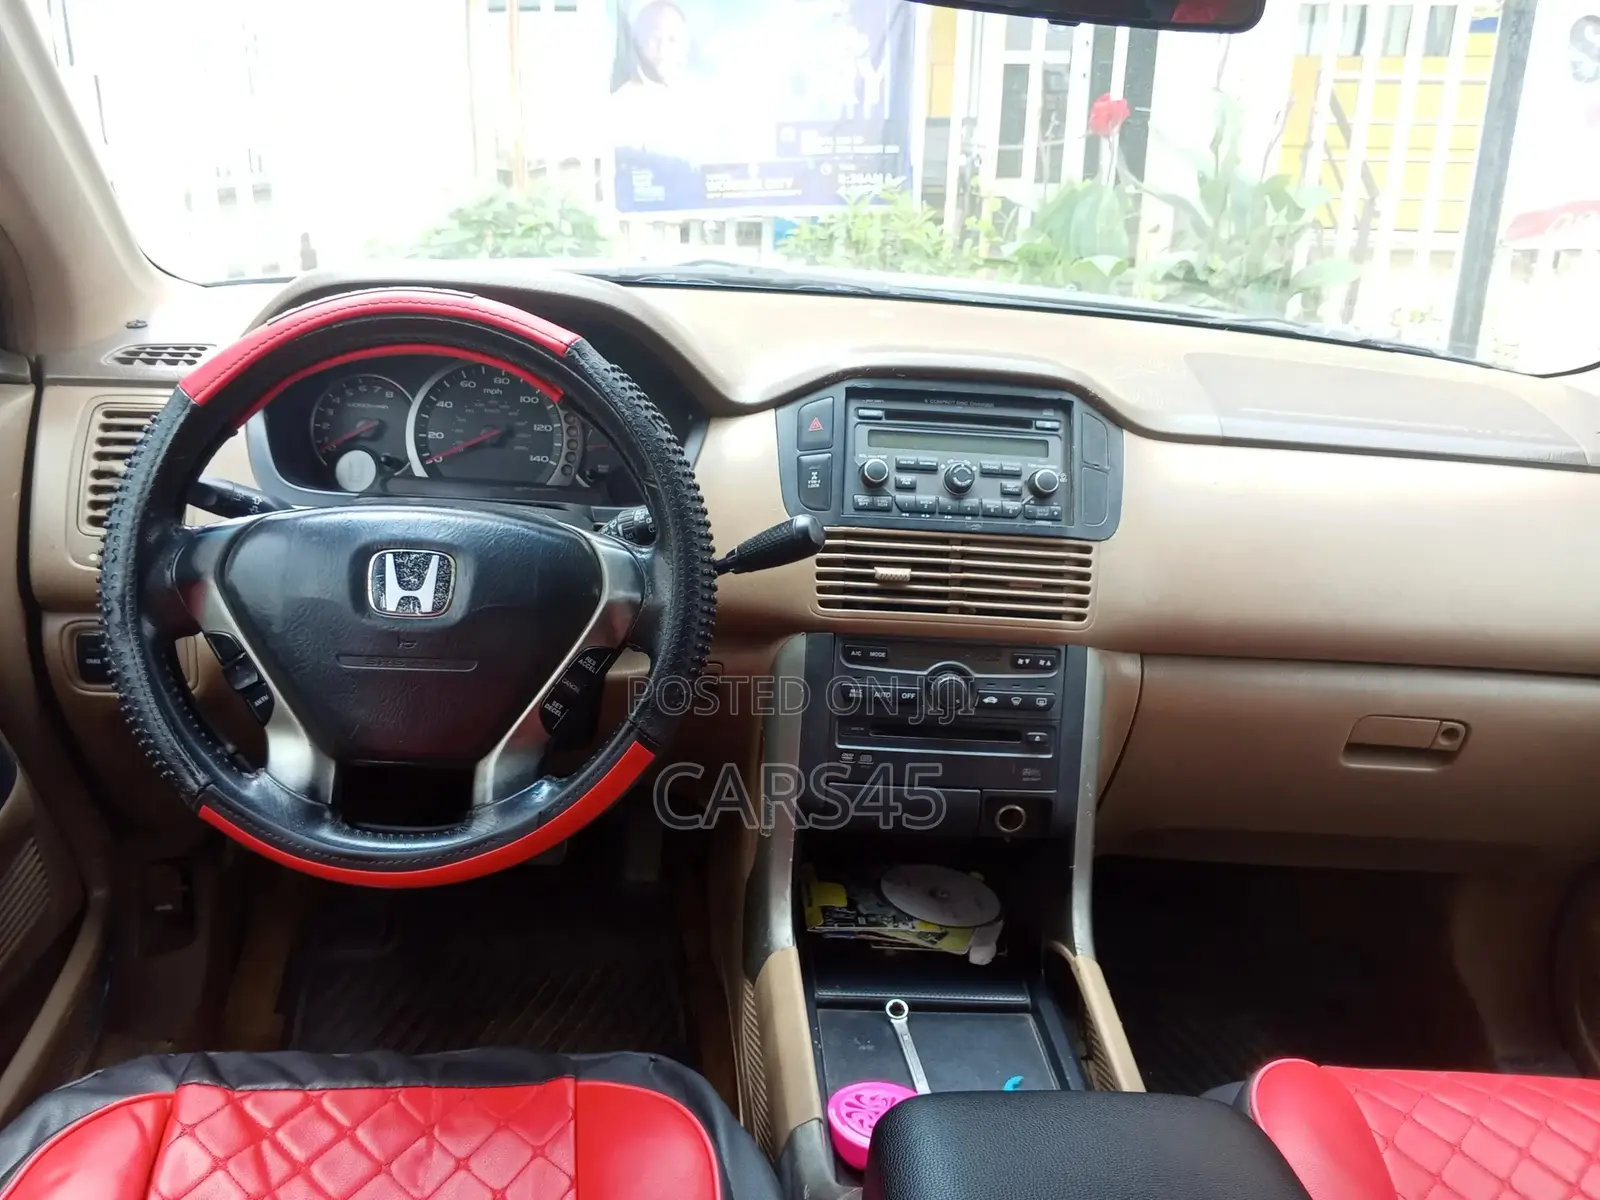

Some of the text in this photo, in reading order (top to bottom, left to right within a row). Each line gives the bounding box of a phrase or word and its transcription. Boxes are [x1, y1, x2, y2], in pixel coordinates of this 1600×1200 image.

[460, 380, 477, 388] 60
[493, 377, 510, 385] 80
[520, 396, 539, 404] 100
[436, 401, 454, 409] 40
[533, 424, 553, 433] 120
[427, 431, 444, 440] 20
[529, 454, 549, 463] 140
[578, 659, 596, 674] ACCEL
